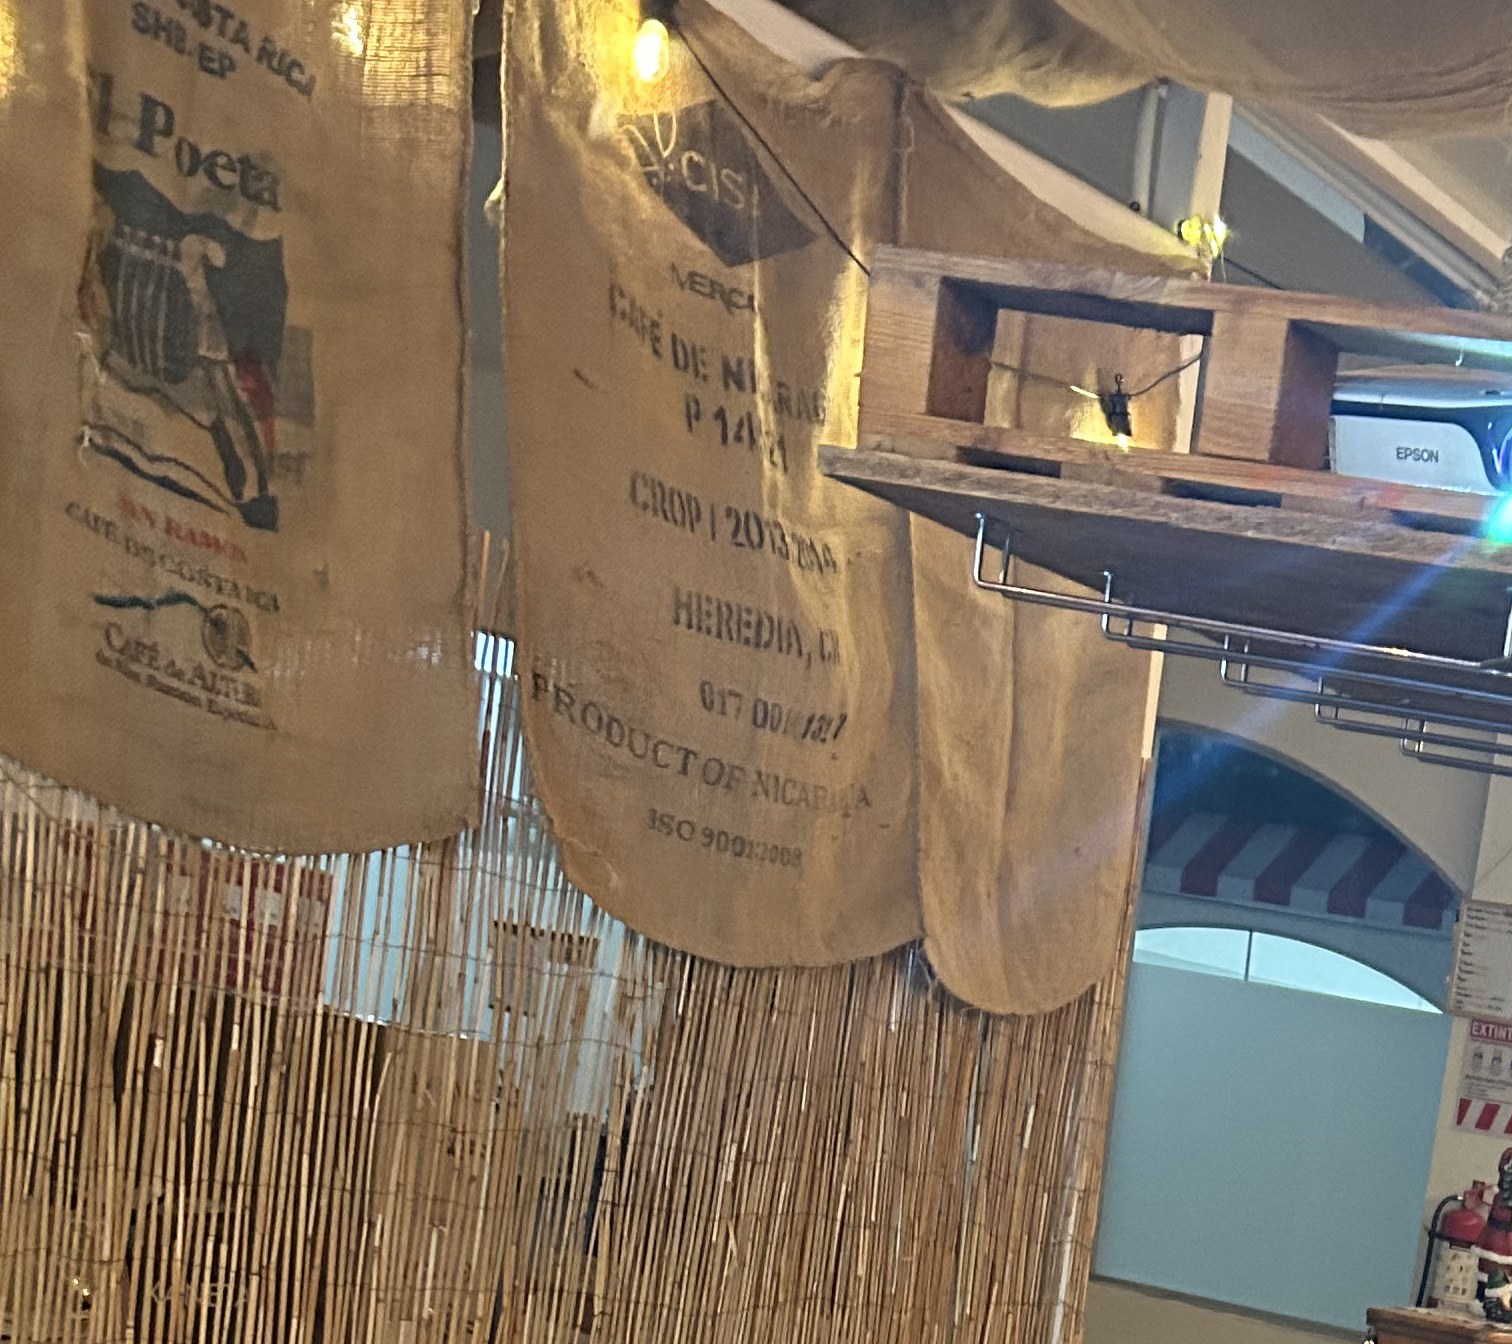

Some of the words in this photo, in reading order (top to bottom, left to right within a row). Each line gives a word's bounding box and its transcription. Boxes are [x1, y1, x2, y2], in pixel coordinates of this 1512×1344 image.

[135, 92, 282, 212] Poeta
[1396, 446, 1439, 463] EPSON
[630, 470, 701, 534] CROP
[672, 586, 812, 671] HEREDIA,
[532, 671, 699, 776] PRODUCT
[703, 757, 746, 791] OF
[648, 808, 697, 843] ISO
